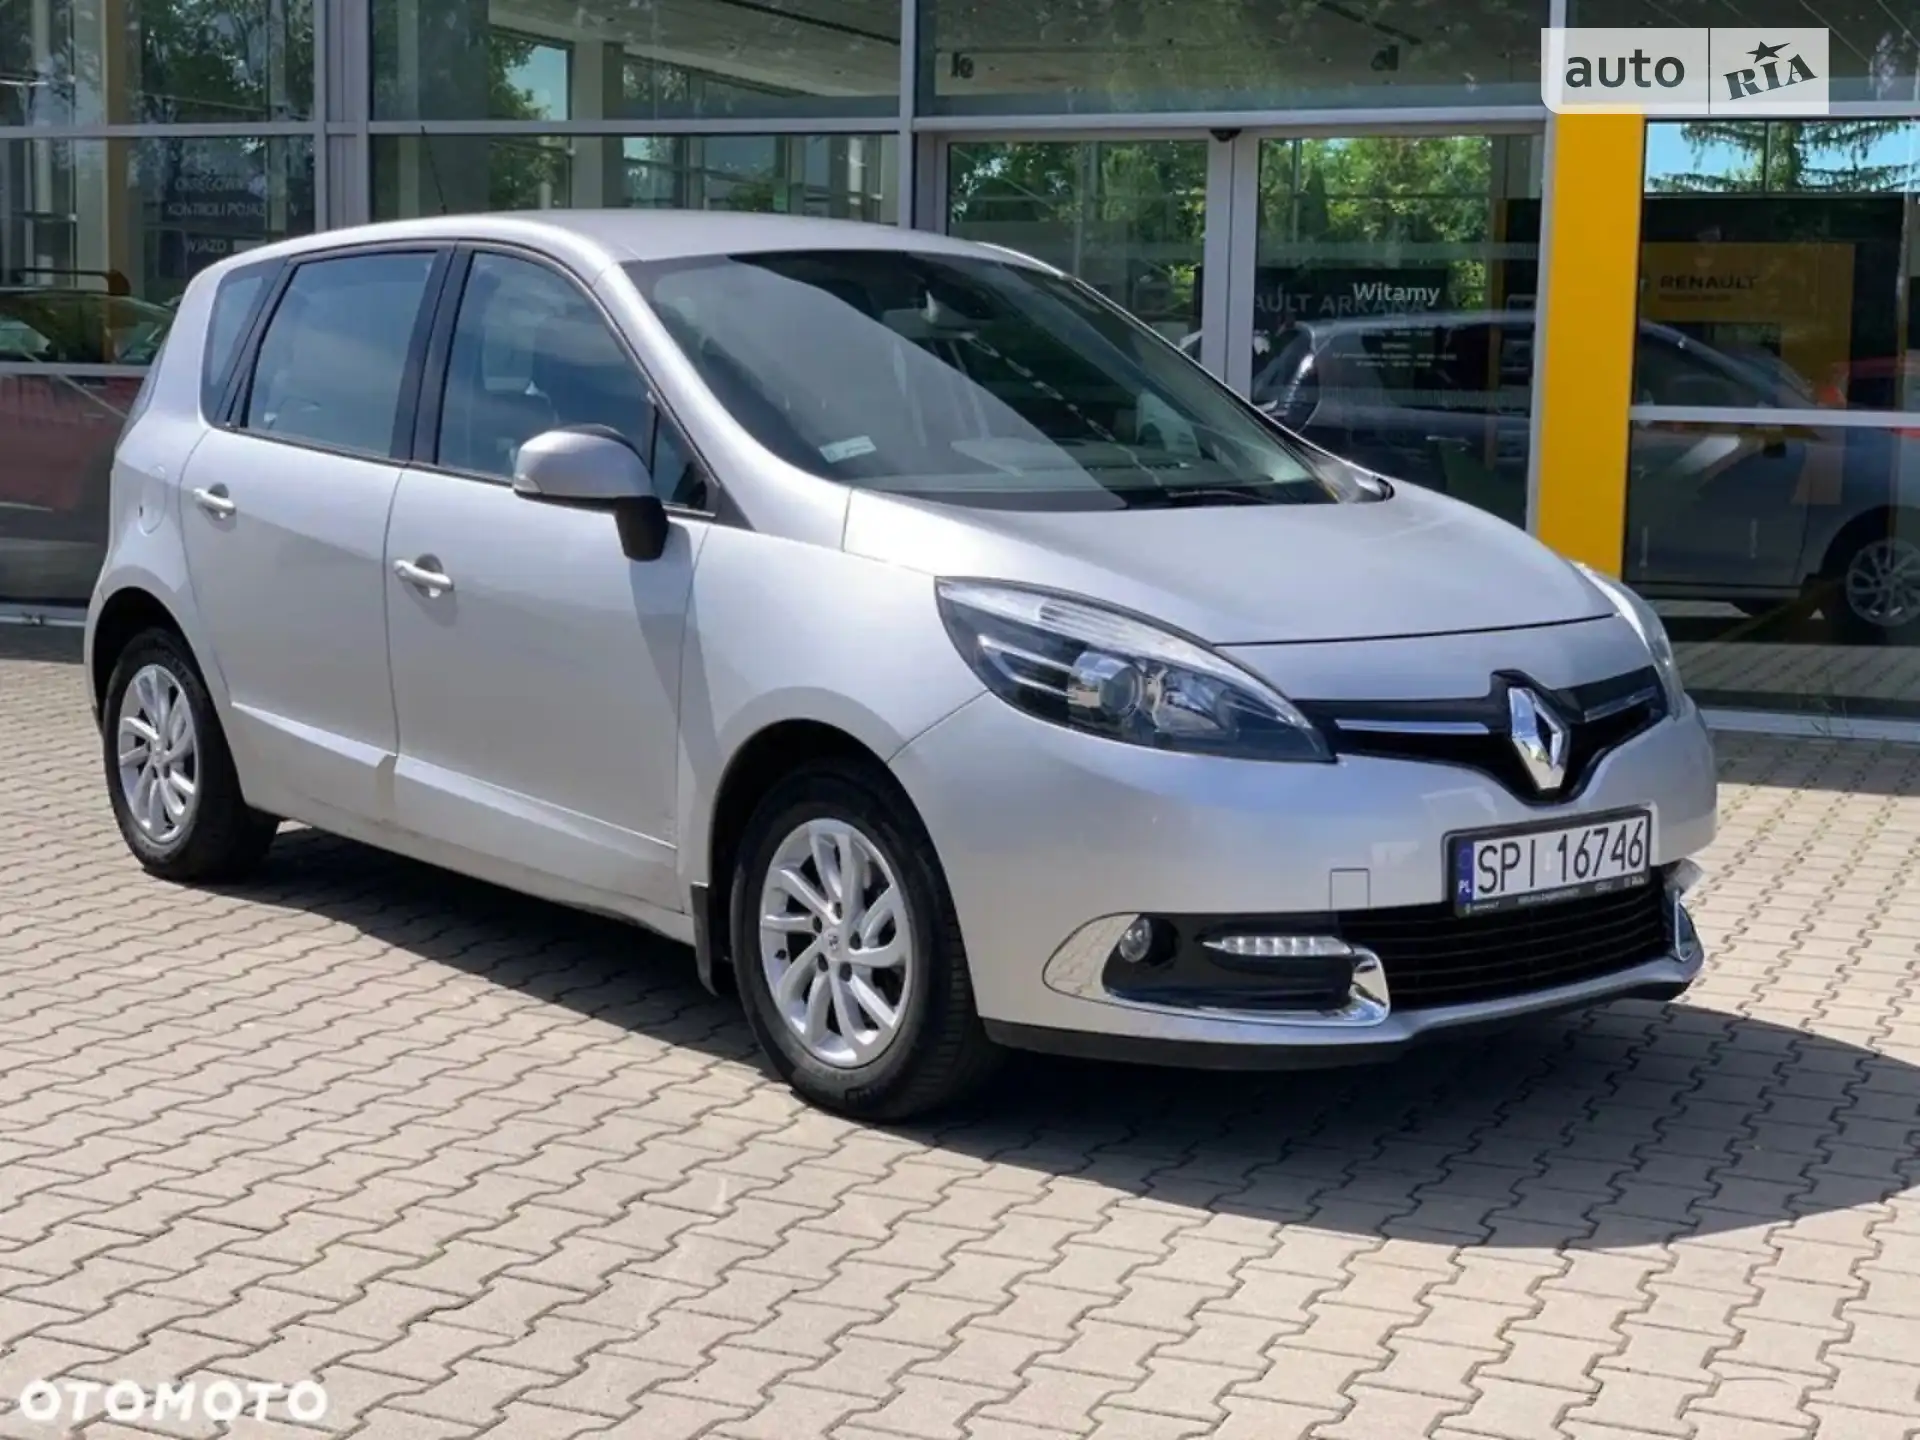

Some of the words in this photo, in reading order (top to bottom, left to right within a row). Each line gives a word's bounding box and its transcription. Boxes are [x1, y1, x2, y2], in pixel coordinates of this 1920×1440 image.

[1660, 275, 1758, 289] RENAULT
[1319, 293, 1425, 314] ARKANA
[1352, 282, 1440, 306] Witamy
[1478, 839, 1536, 894] SPI
[1557, 821, 1645, 882] 16746
[1458, 880, 1471, 893] PL
